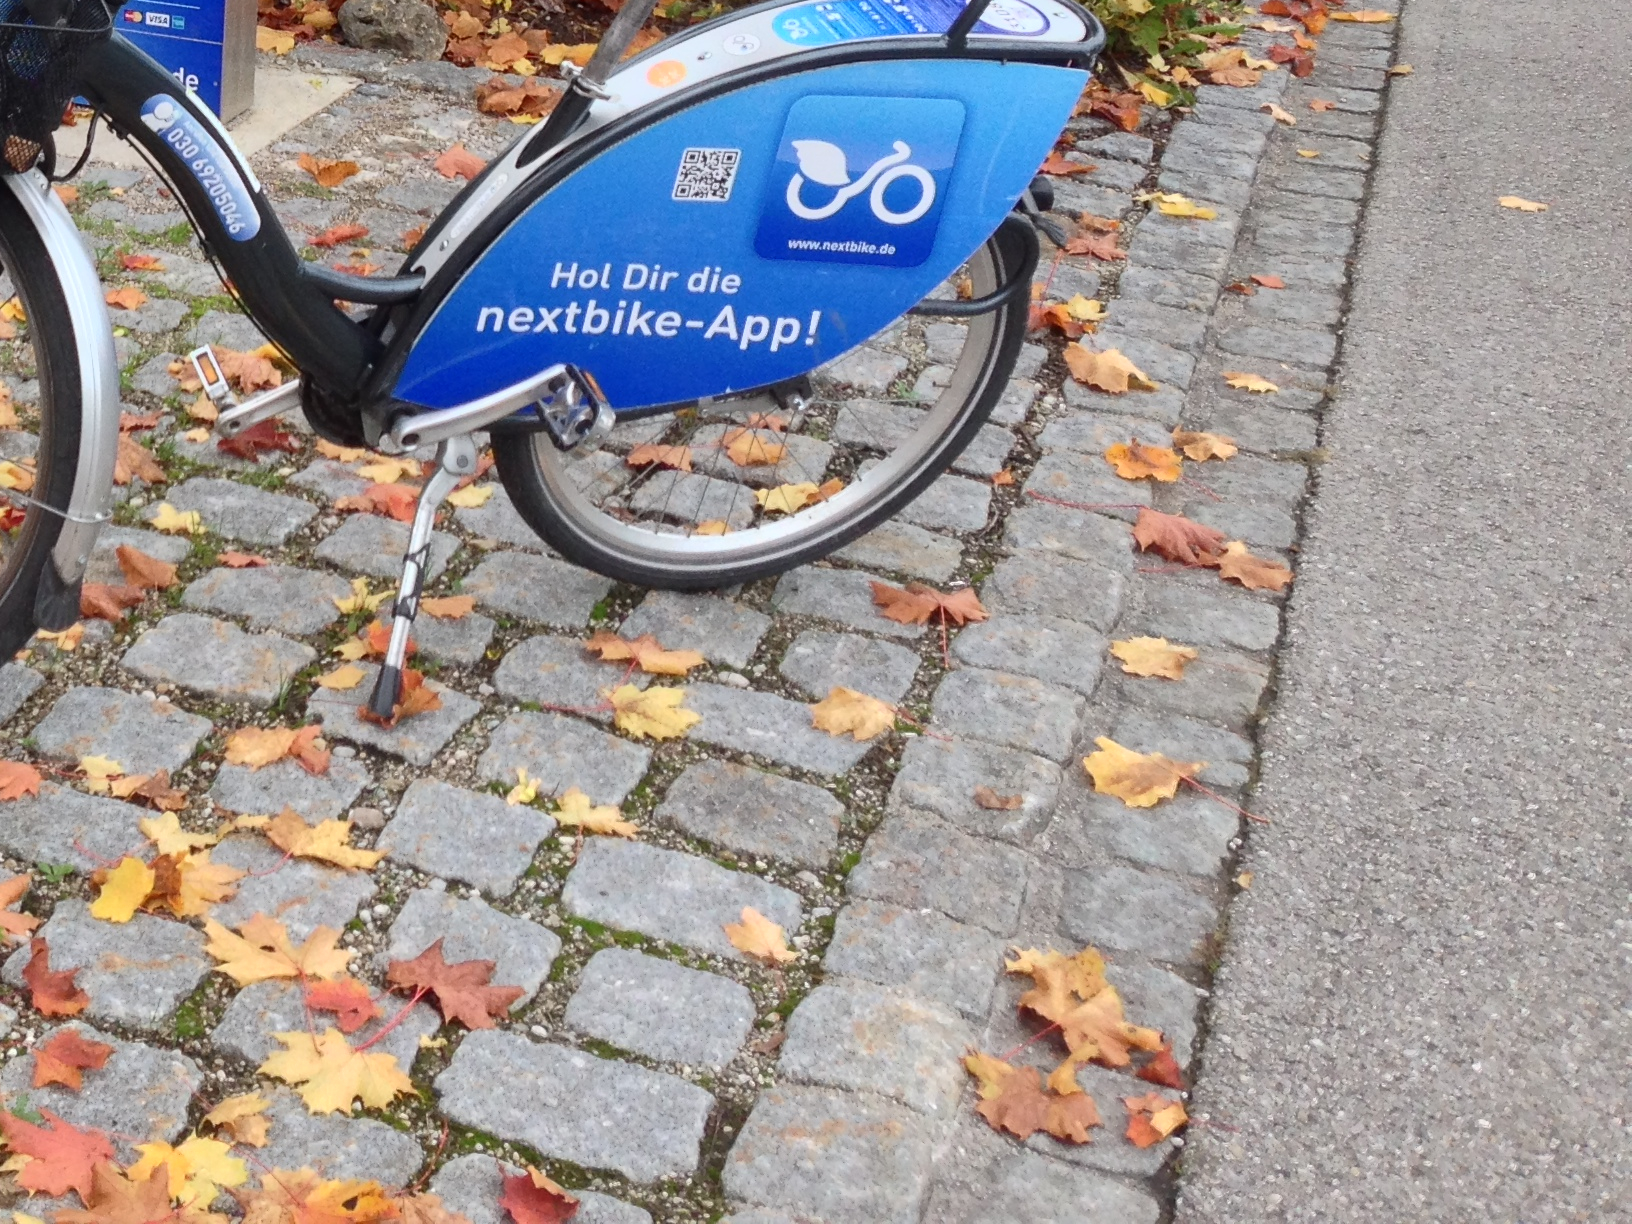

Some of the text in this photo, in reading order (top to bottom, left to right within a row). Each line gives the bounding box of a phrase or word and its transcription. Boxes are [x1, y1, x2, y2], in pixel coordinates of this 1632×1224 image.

[148, 15, 169, 25] VISA
[168, 128, 200, 159] 030
[192, 158, 246, 234] 69205046
[787, 236, 897, 256] www.nextbike.de
[550, 261, 742, 294] Hol Dir die
[476, 299, 822, 352] nextbike-App!
